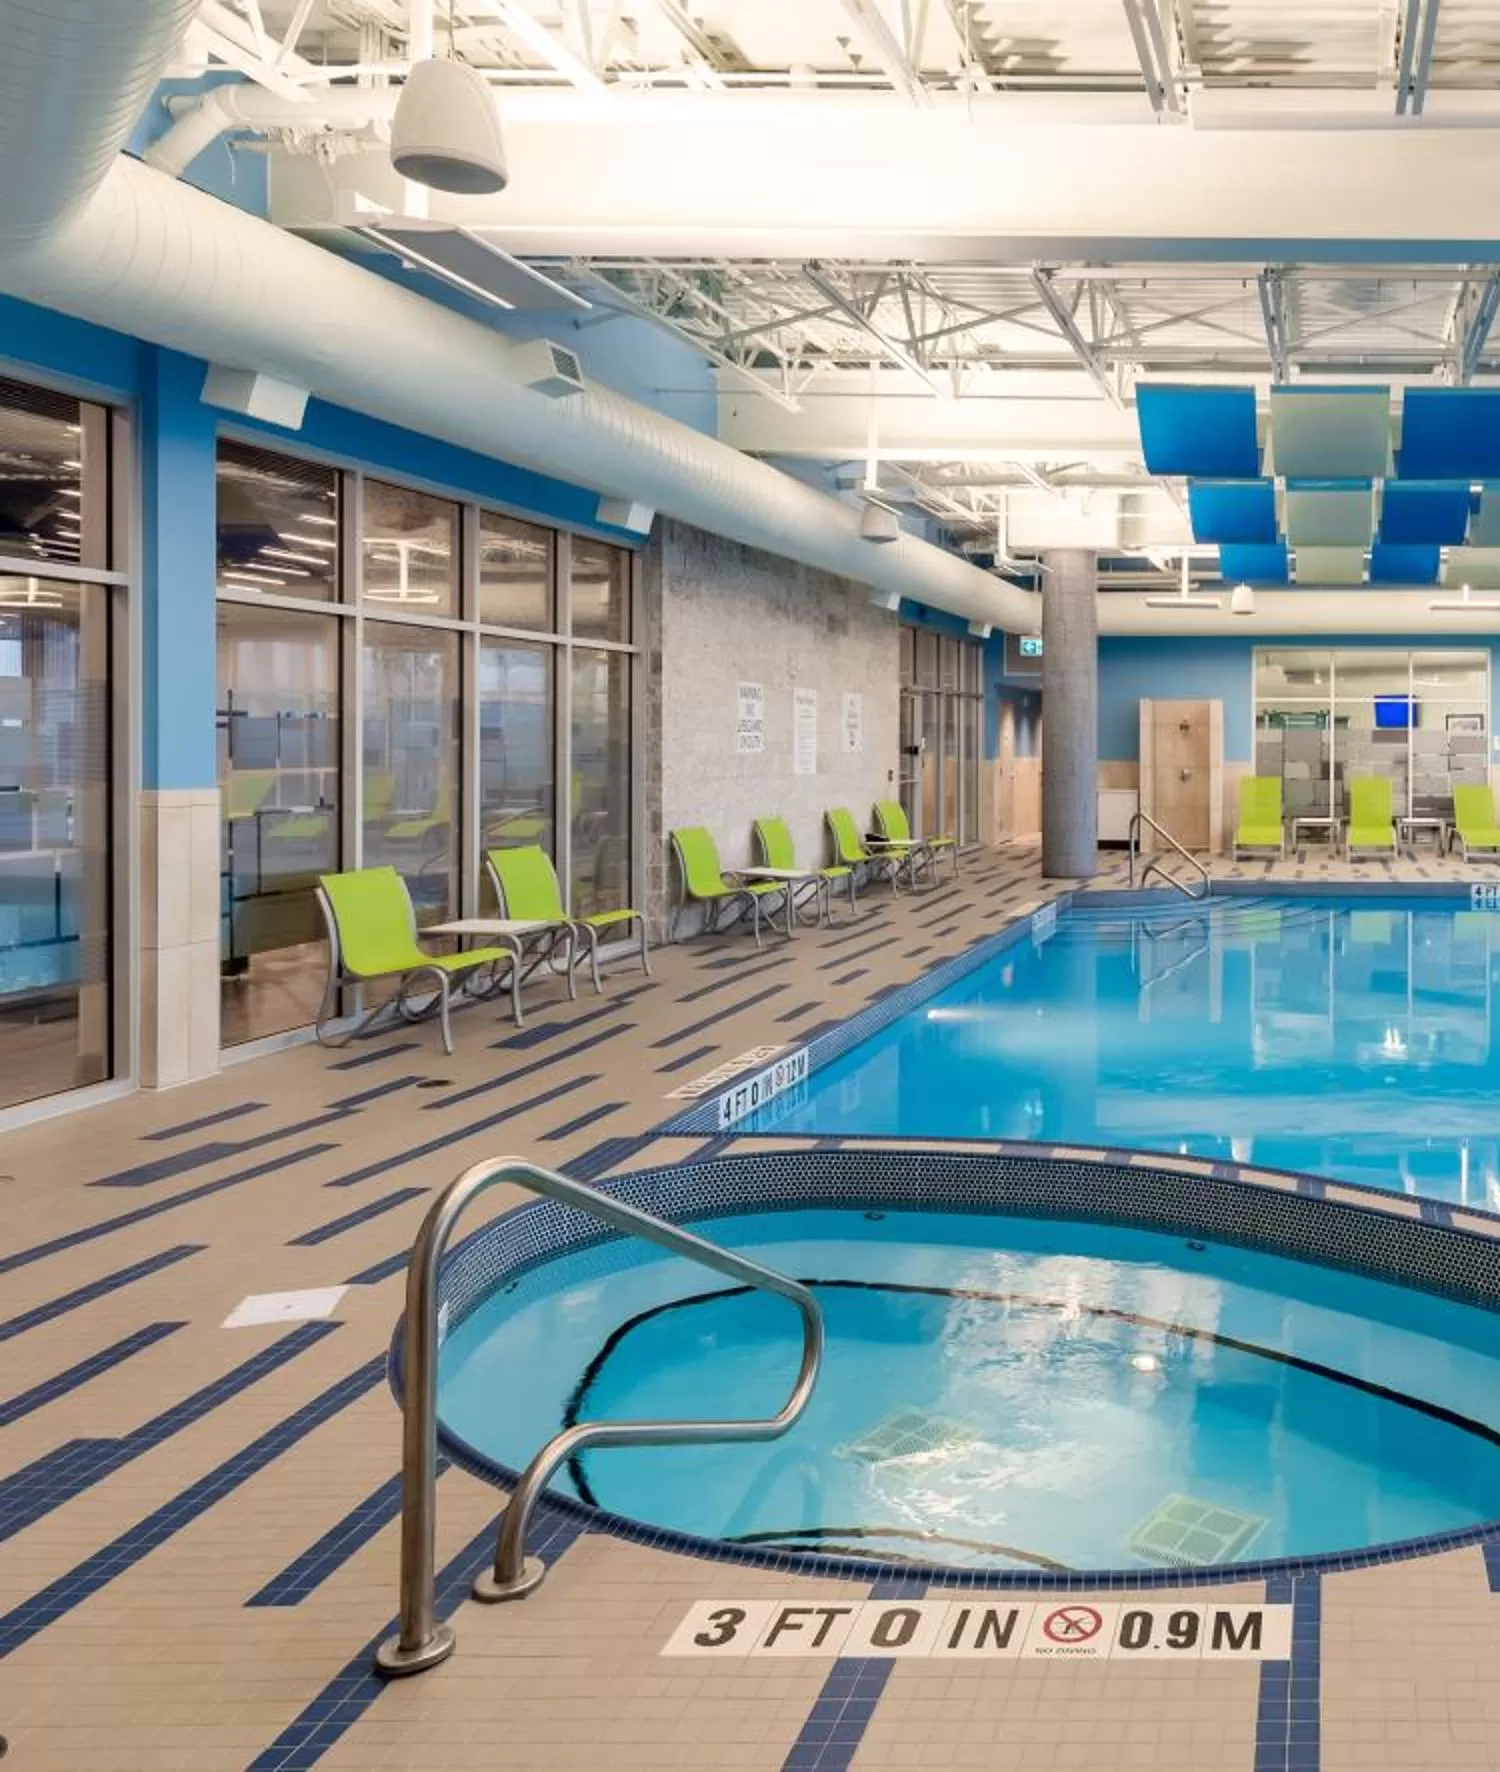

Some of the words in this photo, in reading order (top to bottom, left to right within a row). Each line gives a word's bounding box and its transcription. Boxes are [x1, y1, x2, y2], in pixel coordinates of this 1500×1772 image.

[723, 1096, 731, 1122] 4
[735, 1087, 748, 1117] FT
[751, 1081, 759, 1106] 0
[693, 1607, 747, 1648] 3
[763, 1607, 853, 1648] FT
[869, 1607, 922, 1648] 0
[947, 1608, 1020, 1649] IN
